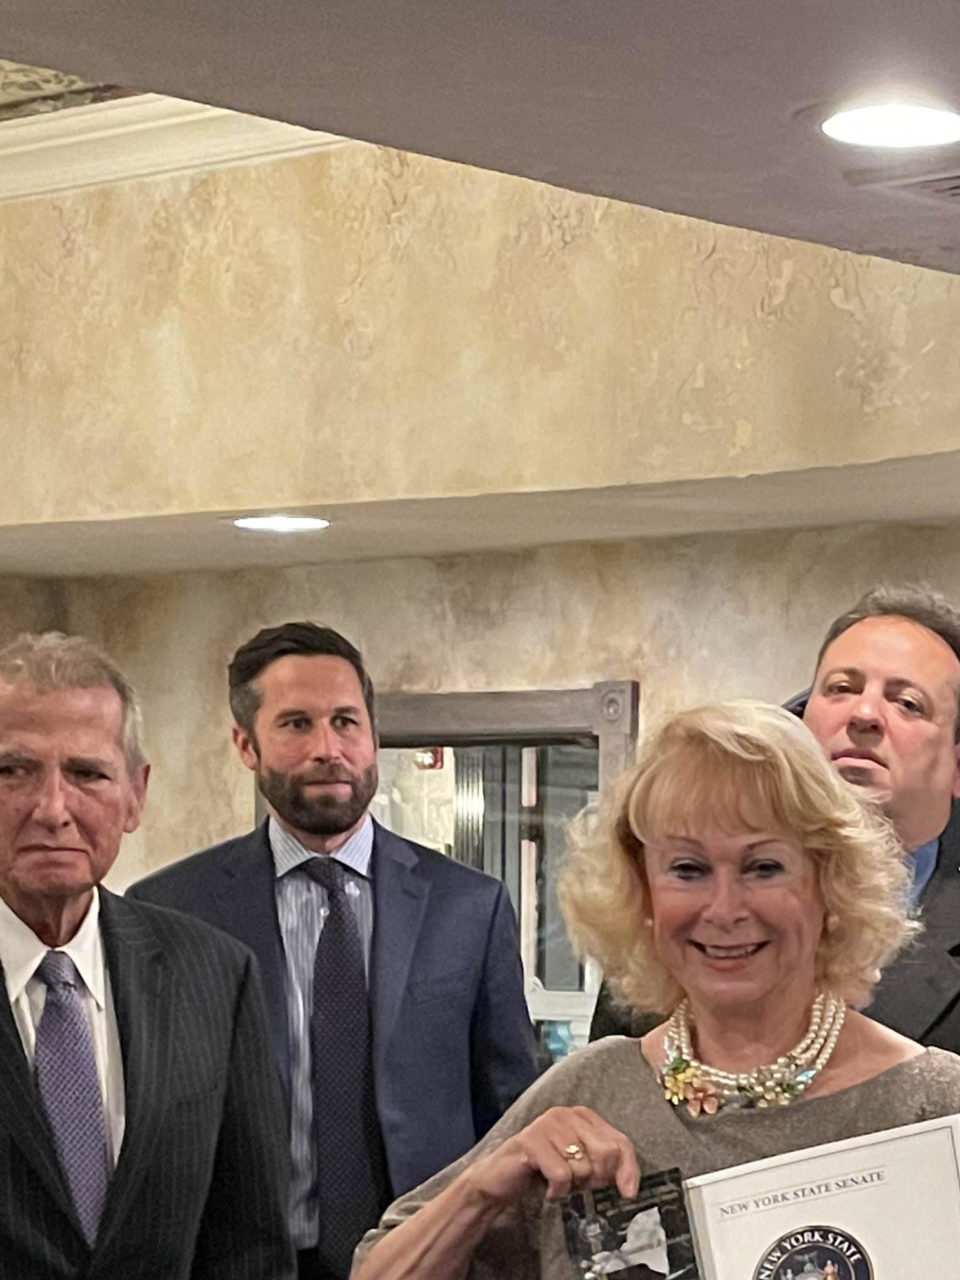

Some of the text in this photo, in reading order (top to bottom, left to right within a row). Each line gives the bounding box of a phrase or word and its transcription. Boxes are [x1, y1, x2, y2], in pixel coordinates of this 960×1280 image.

[719, 1171, 885, 1217] NEW YORK STATE SENATE
[759, 1231, 862, 1280] NEW YORK STATE
